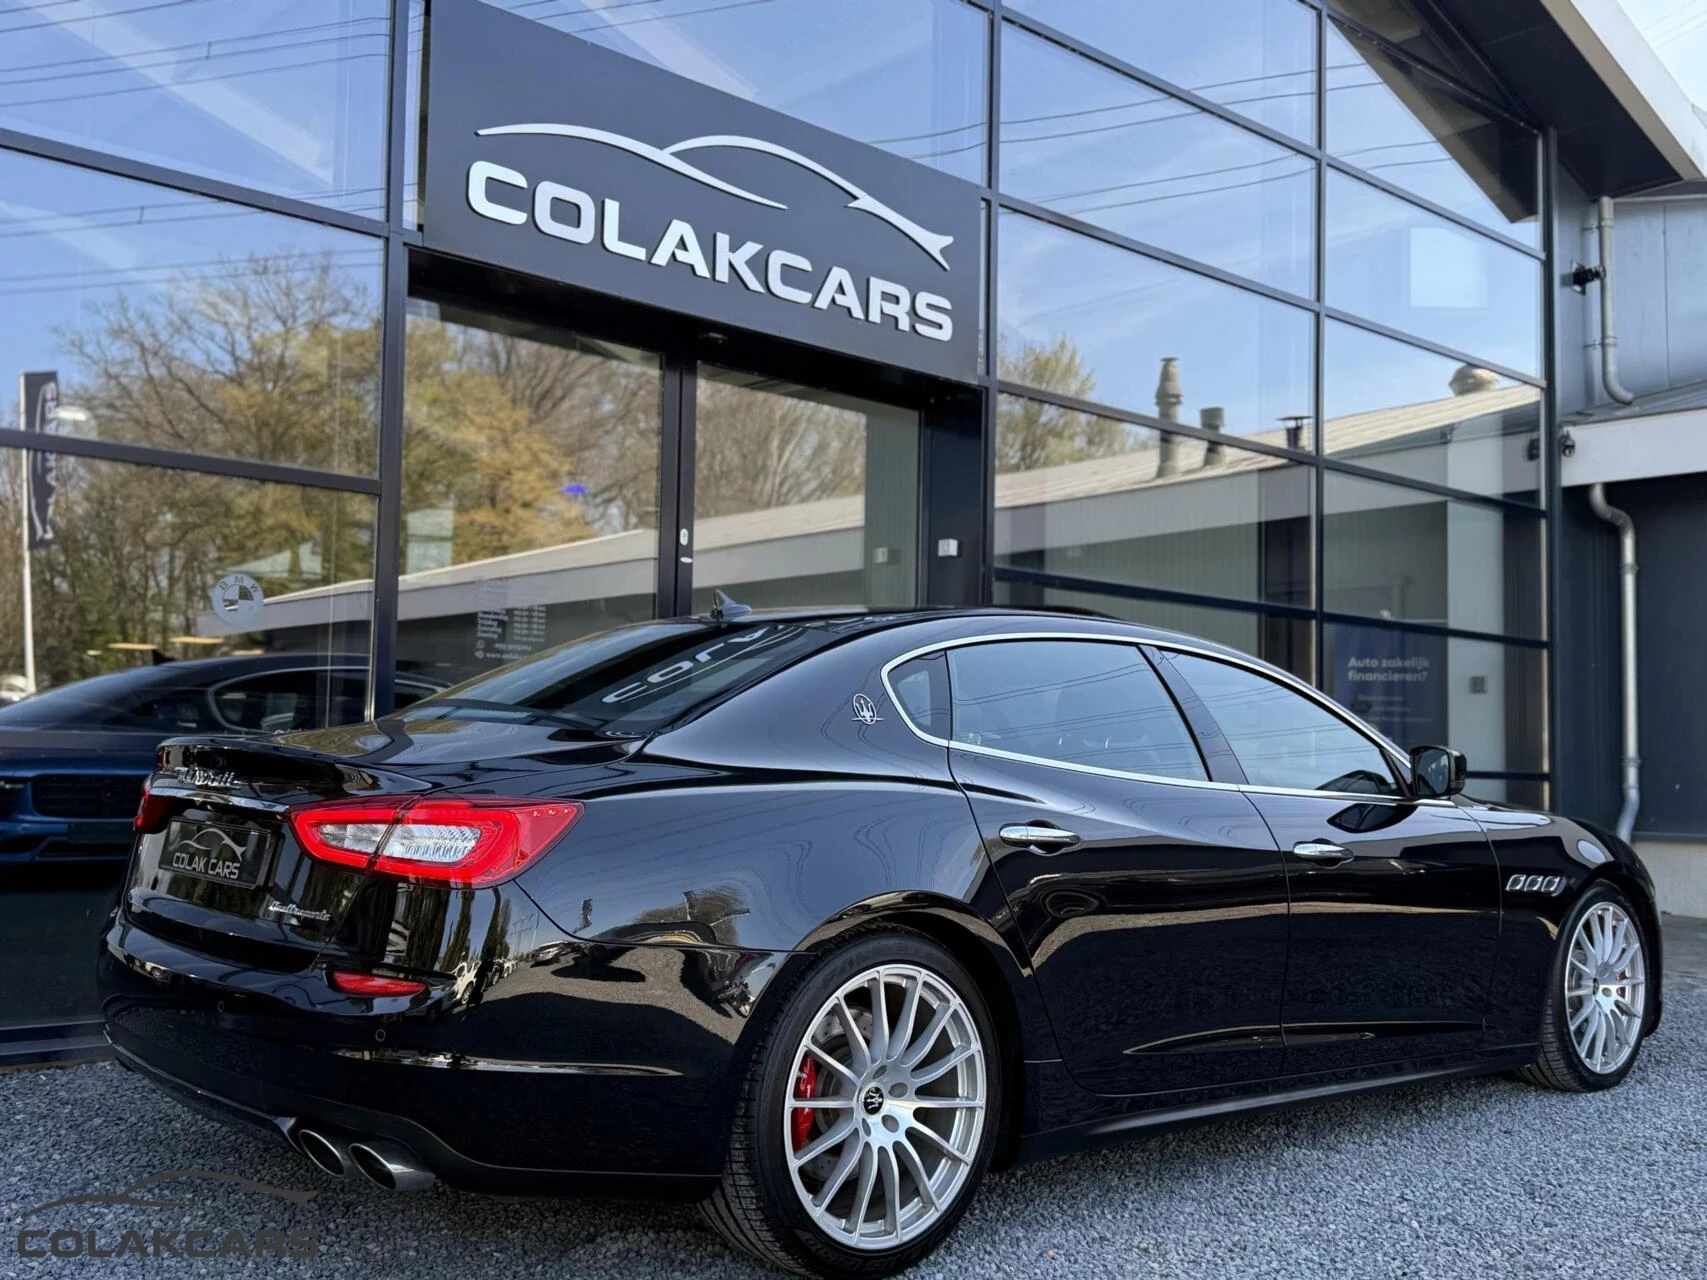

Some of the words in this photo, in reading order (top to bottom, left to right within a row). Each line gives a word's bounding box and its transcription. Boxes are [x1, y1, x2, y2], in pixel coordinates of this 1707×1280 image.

[467, 160, 954, 342] COLAKCARS
[1348, 657, 1379, 668] Auto
[1381, 657, 1430, 671] zakelijk
[1348, 671, 1428, 682] financieren?
[172, 852, 207, 873] COLAK
[207, 858, 240, 880] CARS
